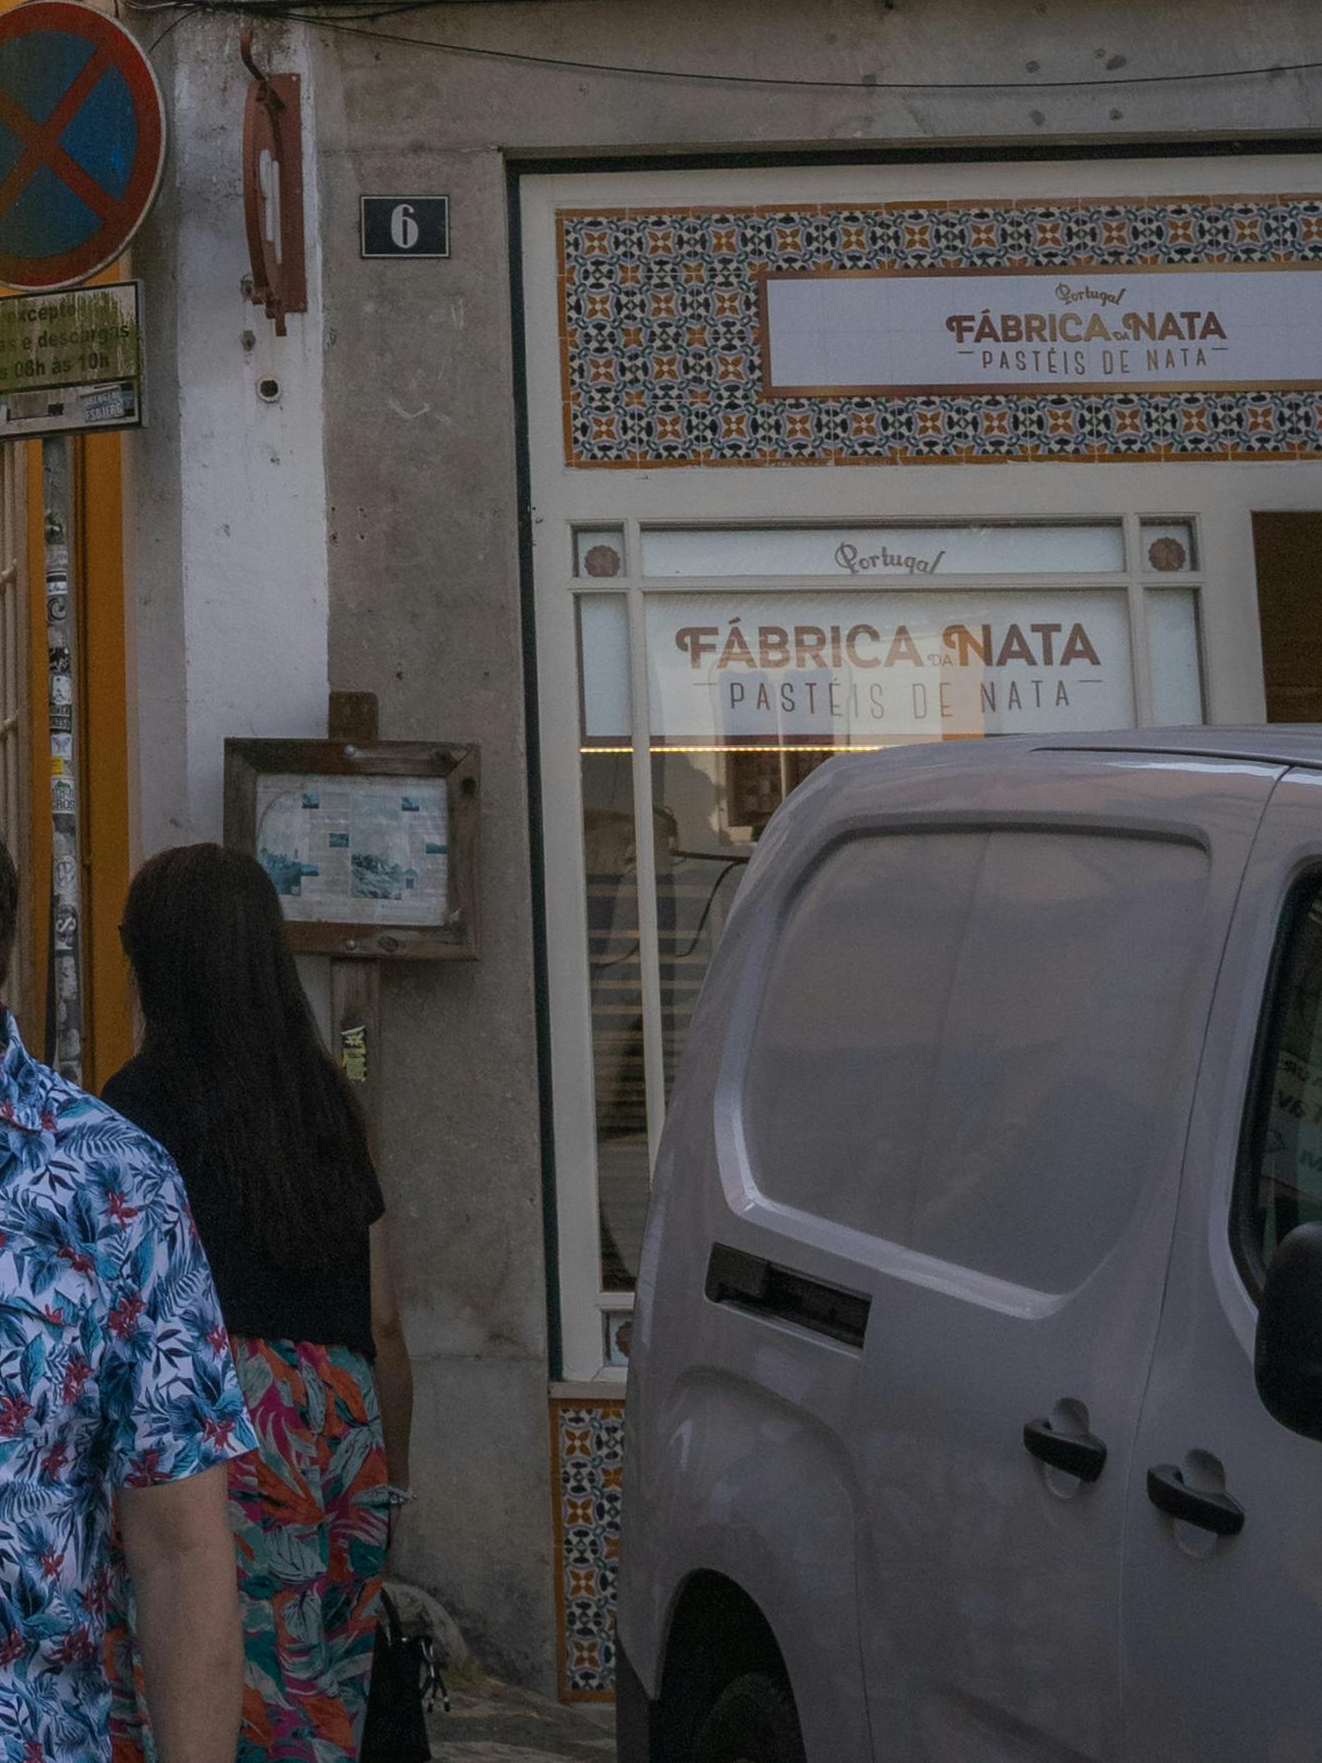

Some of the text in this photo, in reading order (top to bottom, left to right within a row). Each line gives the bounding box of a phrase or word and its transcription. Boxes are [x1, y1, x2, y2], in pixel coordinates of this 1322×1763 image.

[391, 204, 419, 249] 6
[1055, 282, 1126, 307] Portugal
[9, 303, 76, 324] excepto
[945, 308, 1228, 343] FÁBRICA DA NATA
[22, 336, 33, 350] e
[38, 325, 130, 348] descargas
[51, 358, 71, 375] às
[79, 352, 109, 371] 10h
[982, 347, 1207, 375] PASTÉIS DE NATA
[835, 540, 946, 575] Portugal
[674, 617, 1103, 669] FÁBRICA DA NATA
[729, 676, 1071, 720] PASTÉIS DE NATA
